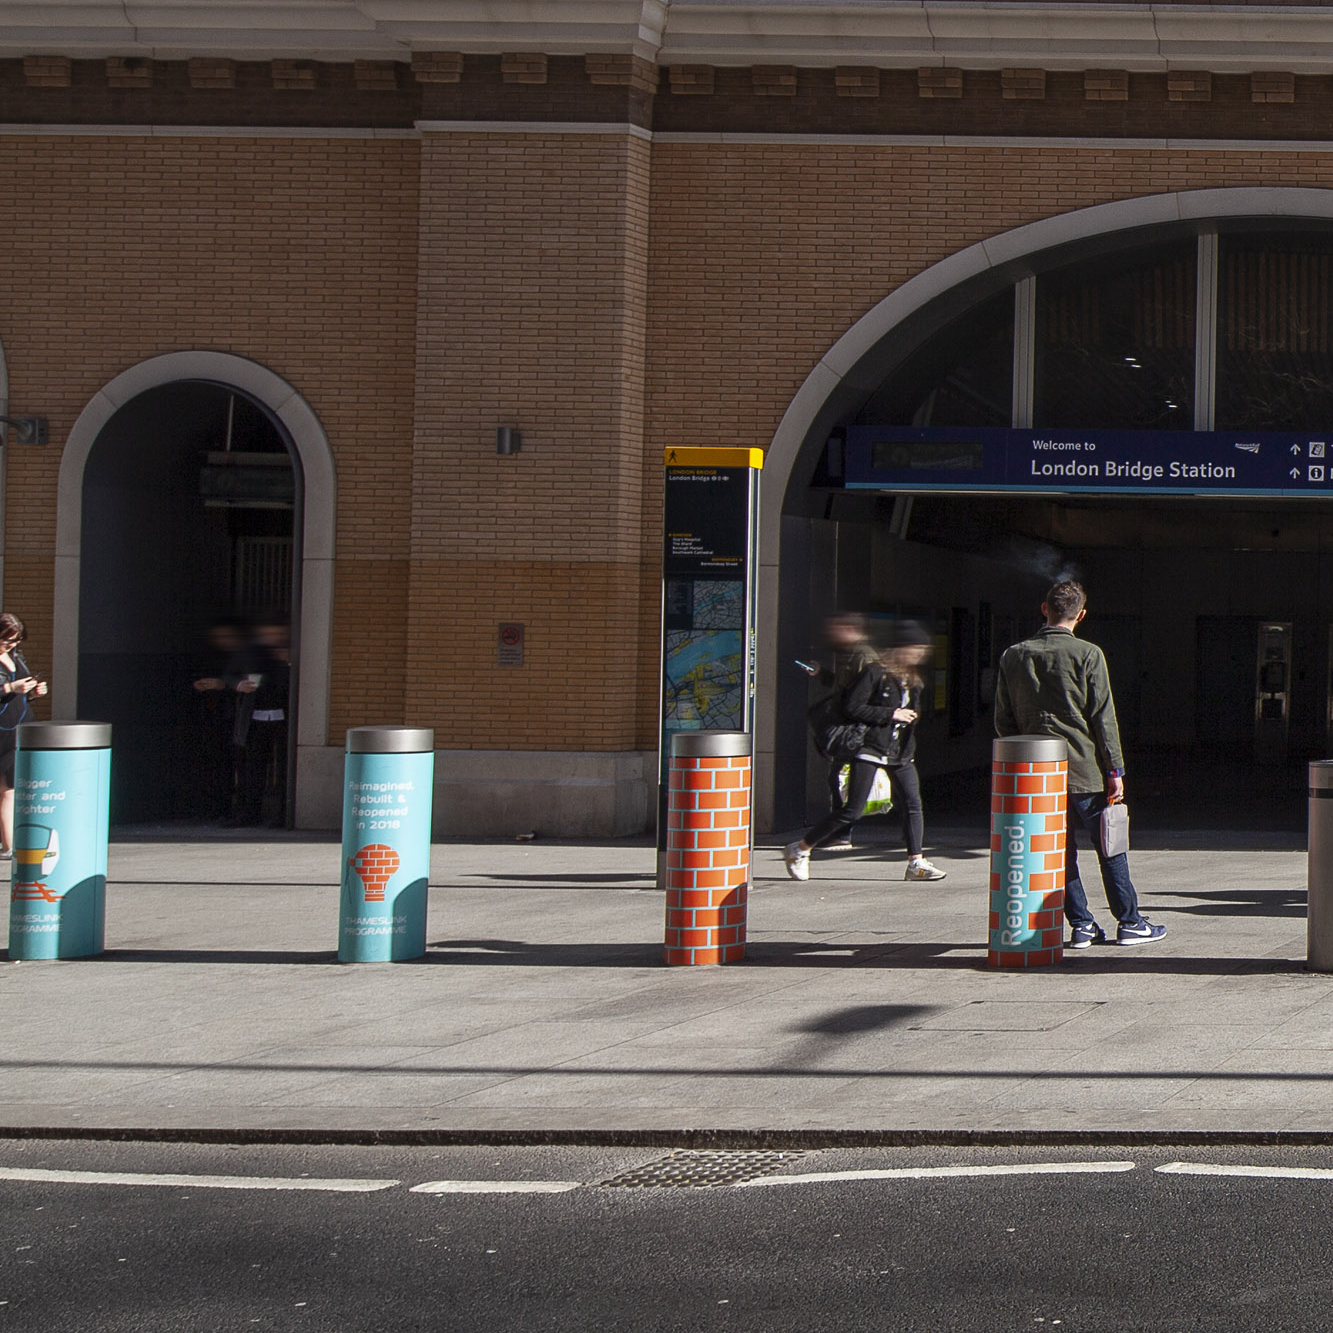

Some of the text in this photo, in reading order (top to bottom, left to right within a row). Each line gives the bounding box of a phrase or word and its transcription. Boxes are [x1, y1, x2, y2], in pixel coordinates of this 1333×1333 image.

[1032, 440, 1096, 451] Welcome to
[1031, 459, 1236, 481] London Bridge Station
[41, 791, 66, 801] and
[353, 794, 407, 804] Rebuilt &
[351, 806, 409, 818] Reopened
[355, 820, 401, 830] in 2018
[1001, 820, 1028, 946] Reopened.
[346, 915, 408, 926] THAMESLINK
[344, 925, 407, 936] PROGRAMME
